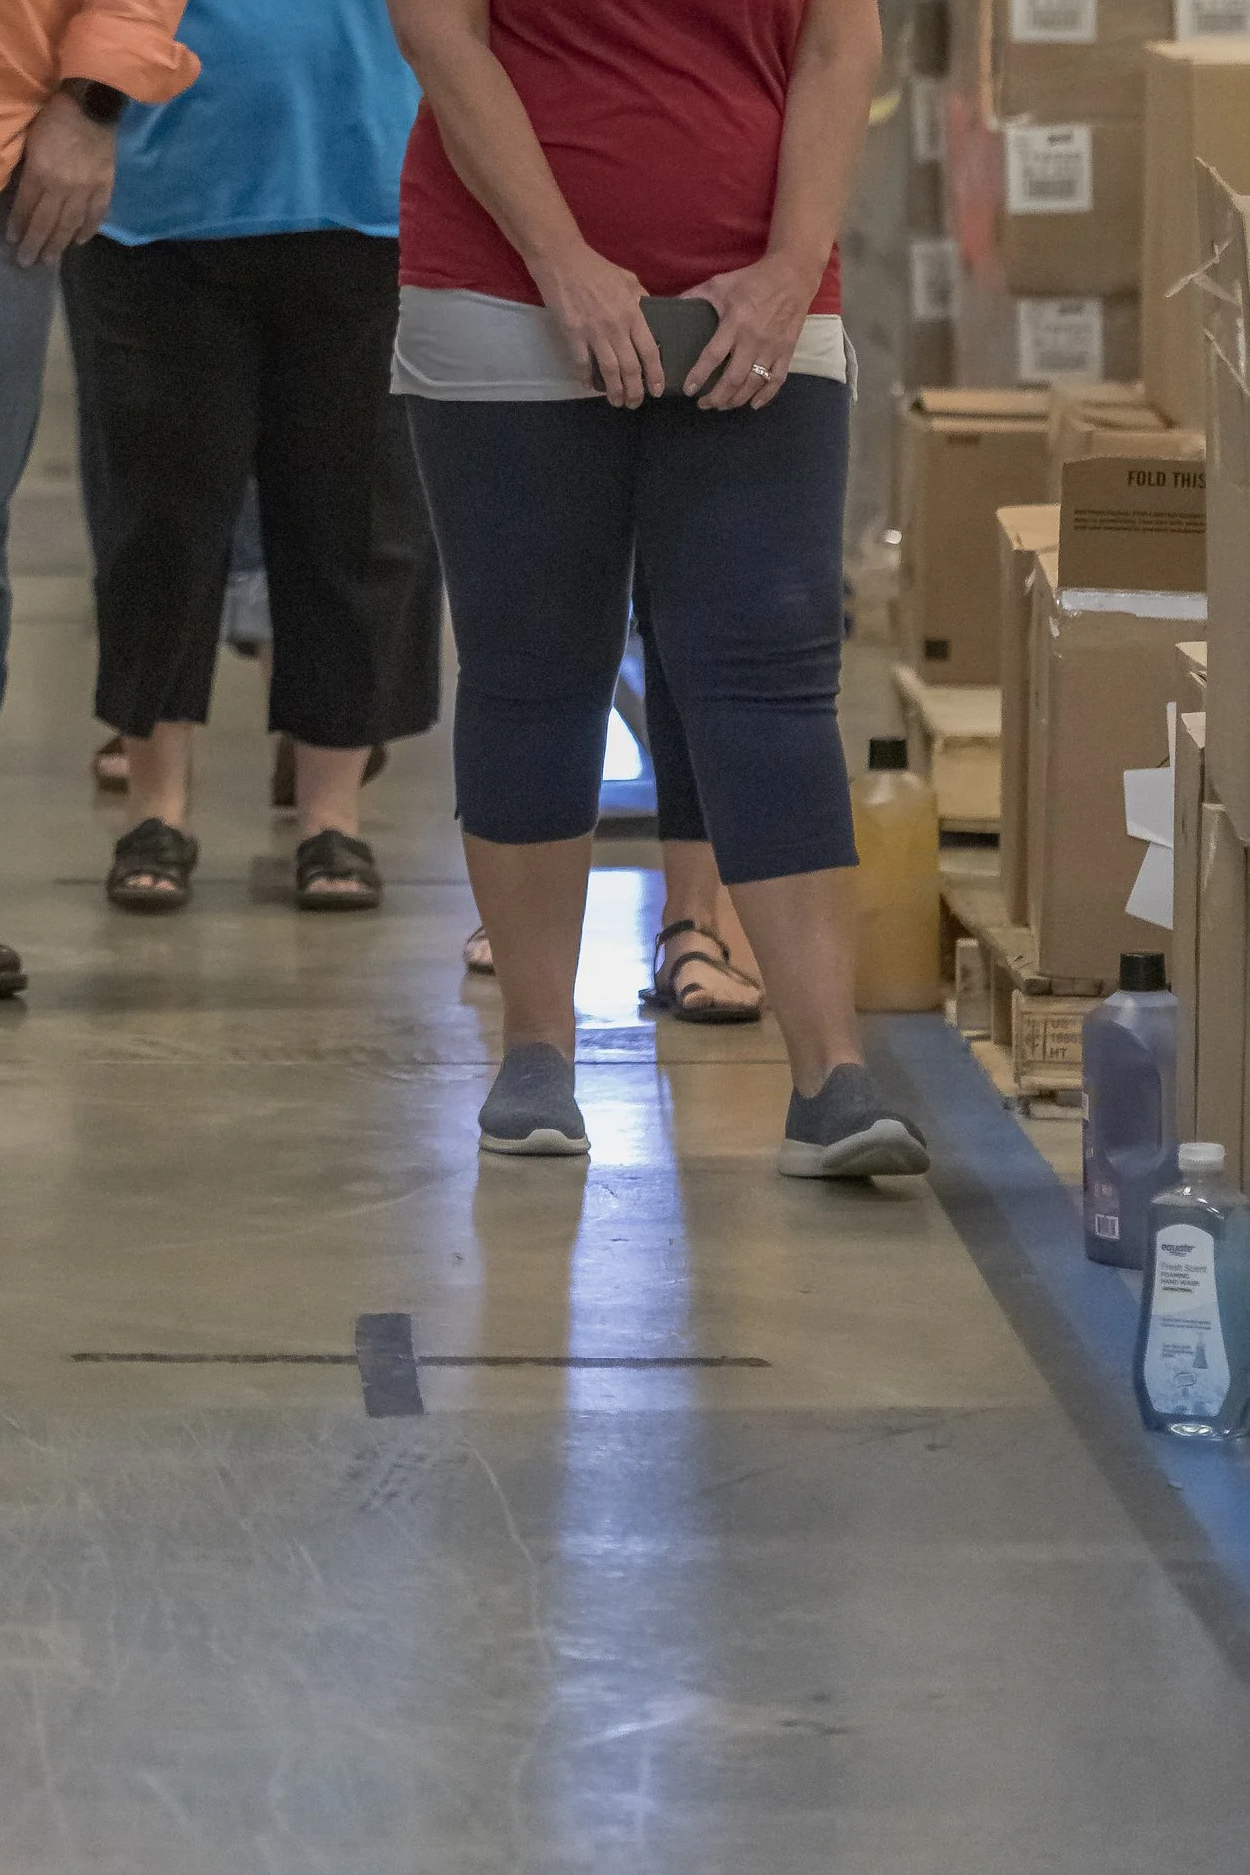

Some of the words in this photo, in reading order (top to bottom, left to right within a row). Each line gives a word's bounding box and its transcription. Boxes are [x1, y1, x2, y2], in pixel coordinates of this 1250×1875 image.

[1127, 470, 1166, 487] FOLD
[1172, 472, 1207, 489] THIS
[1161, 1243, 1195, 1253] equate
[1184, 1264, 1207, 1273] Scent
